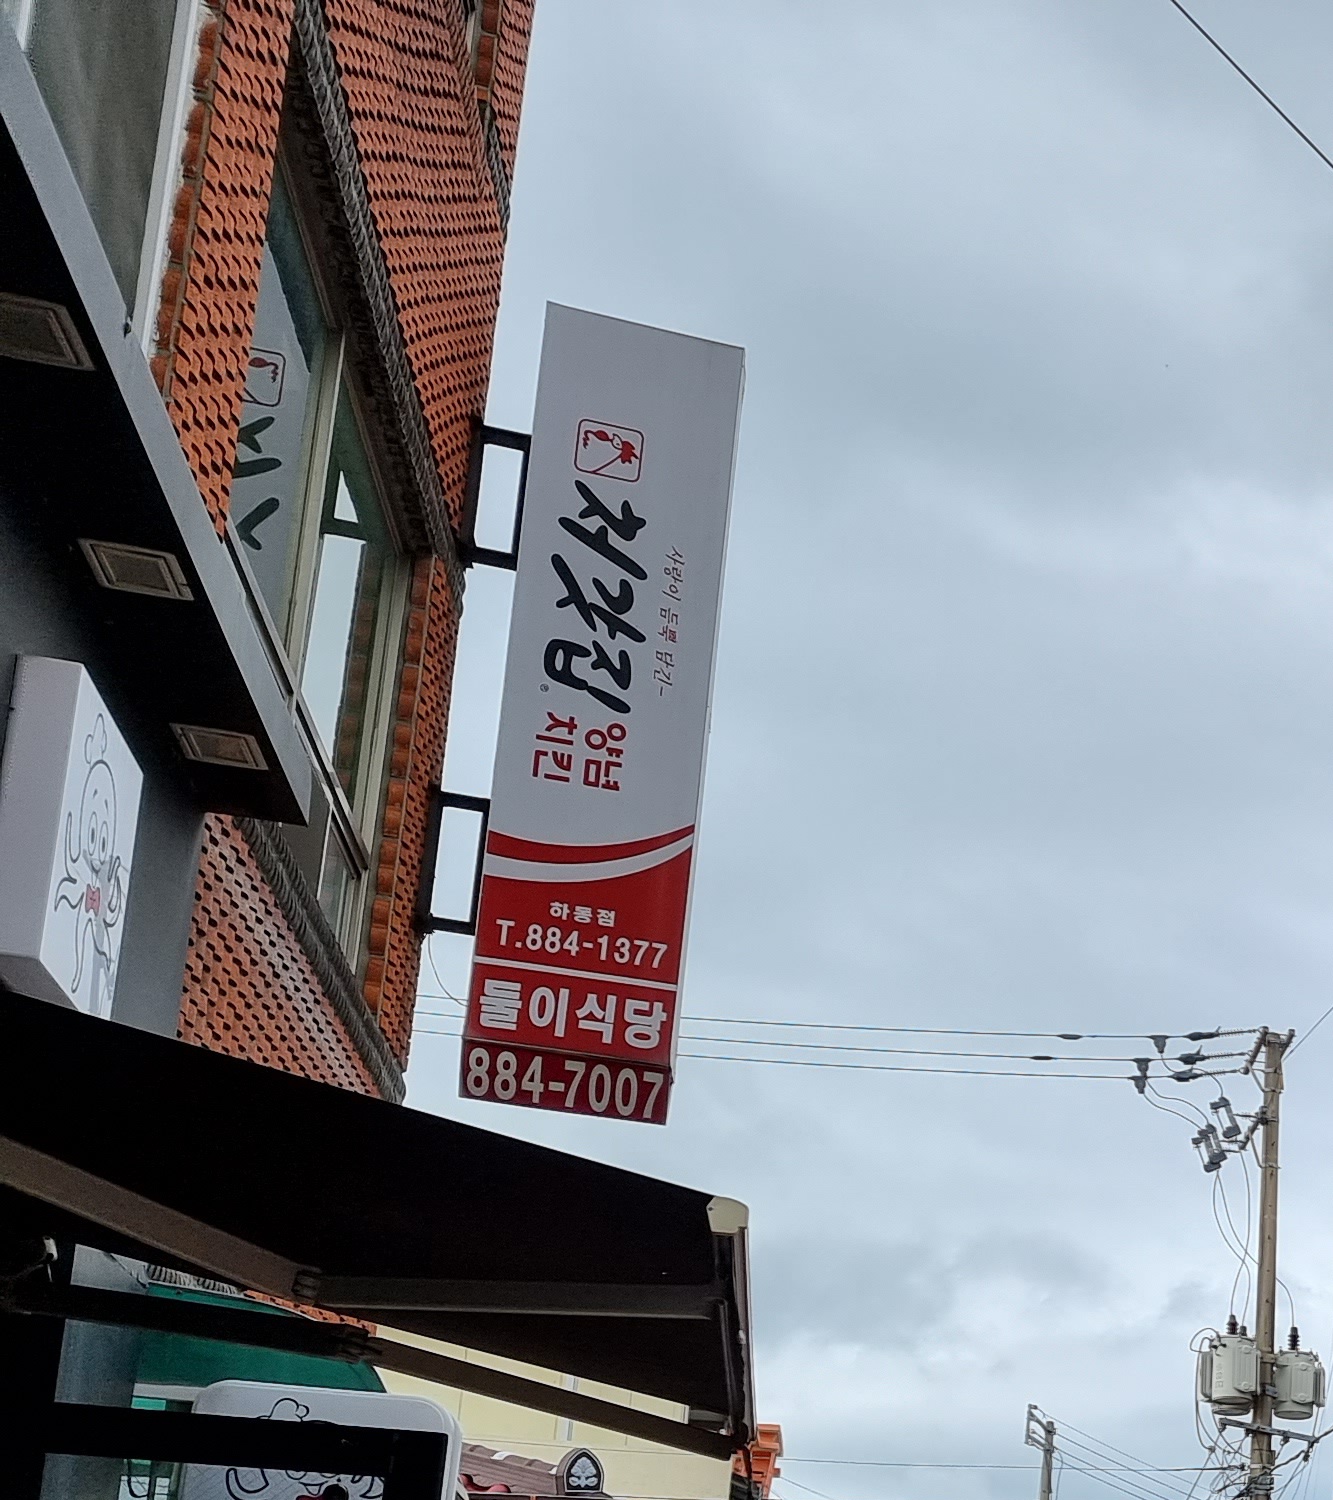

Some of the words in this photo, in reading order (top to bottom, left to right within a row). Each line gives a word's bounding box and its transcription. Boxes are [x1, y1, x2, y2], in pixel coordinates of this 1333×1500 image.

[543, 480, 648, 716] 처갓집
[661, 546, 685, 599] 사랑이
[656, 607, 680, 645] 듬뿍
[531, 711, 579, 784] 치킨
[581, 722, 629, 792] 양념
[495, 918, 668, 969] T.884-1377
[549, 901, 617, 926] 하동점
[478, 977, 668, 1050] 둘이식당
[466, 1047, 664, 1119] 884-7007
